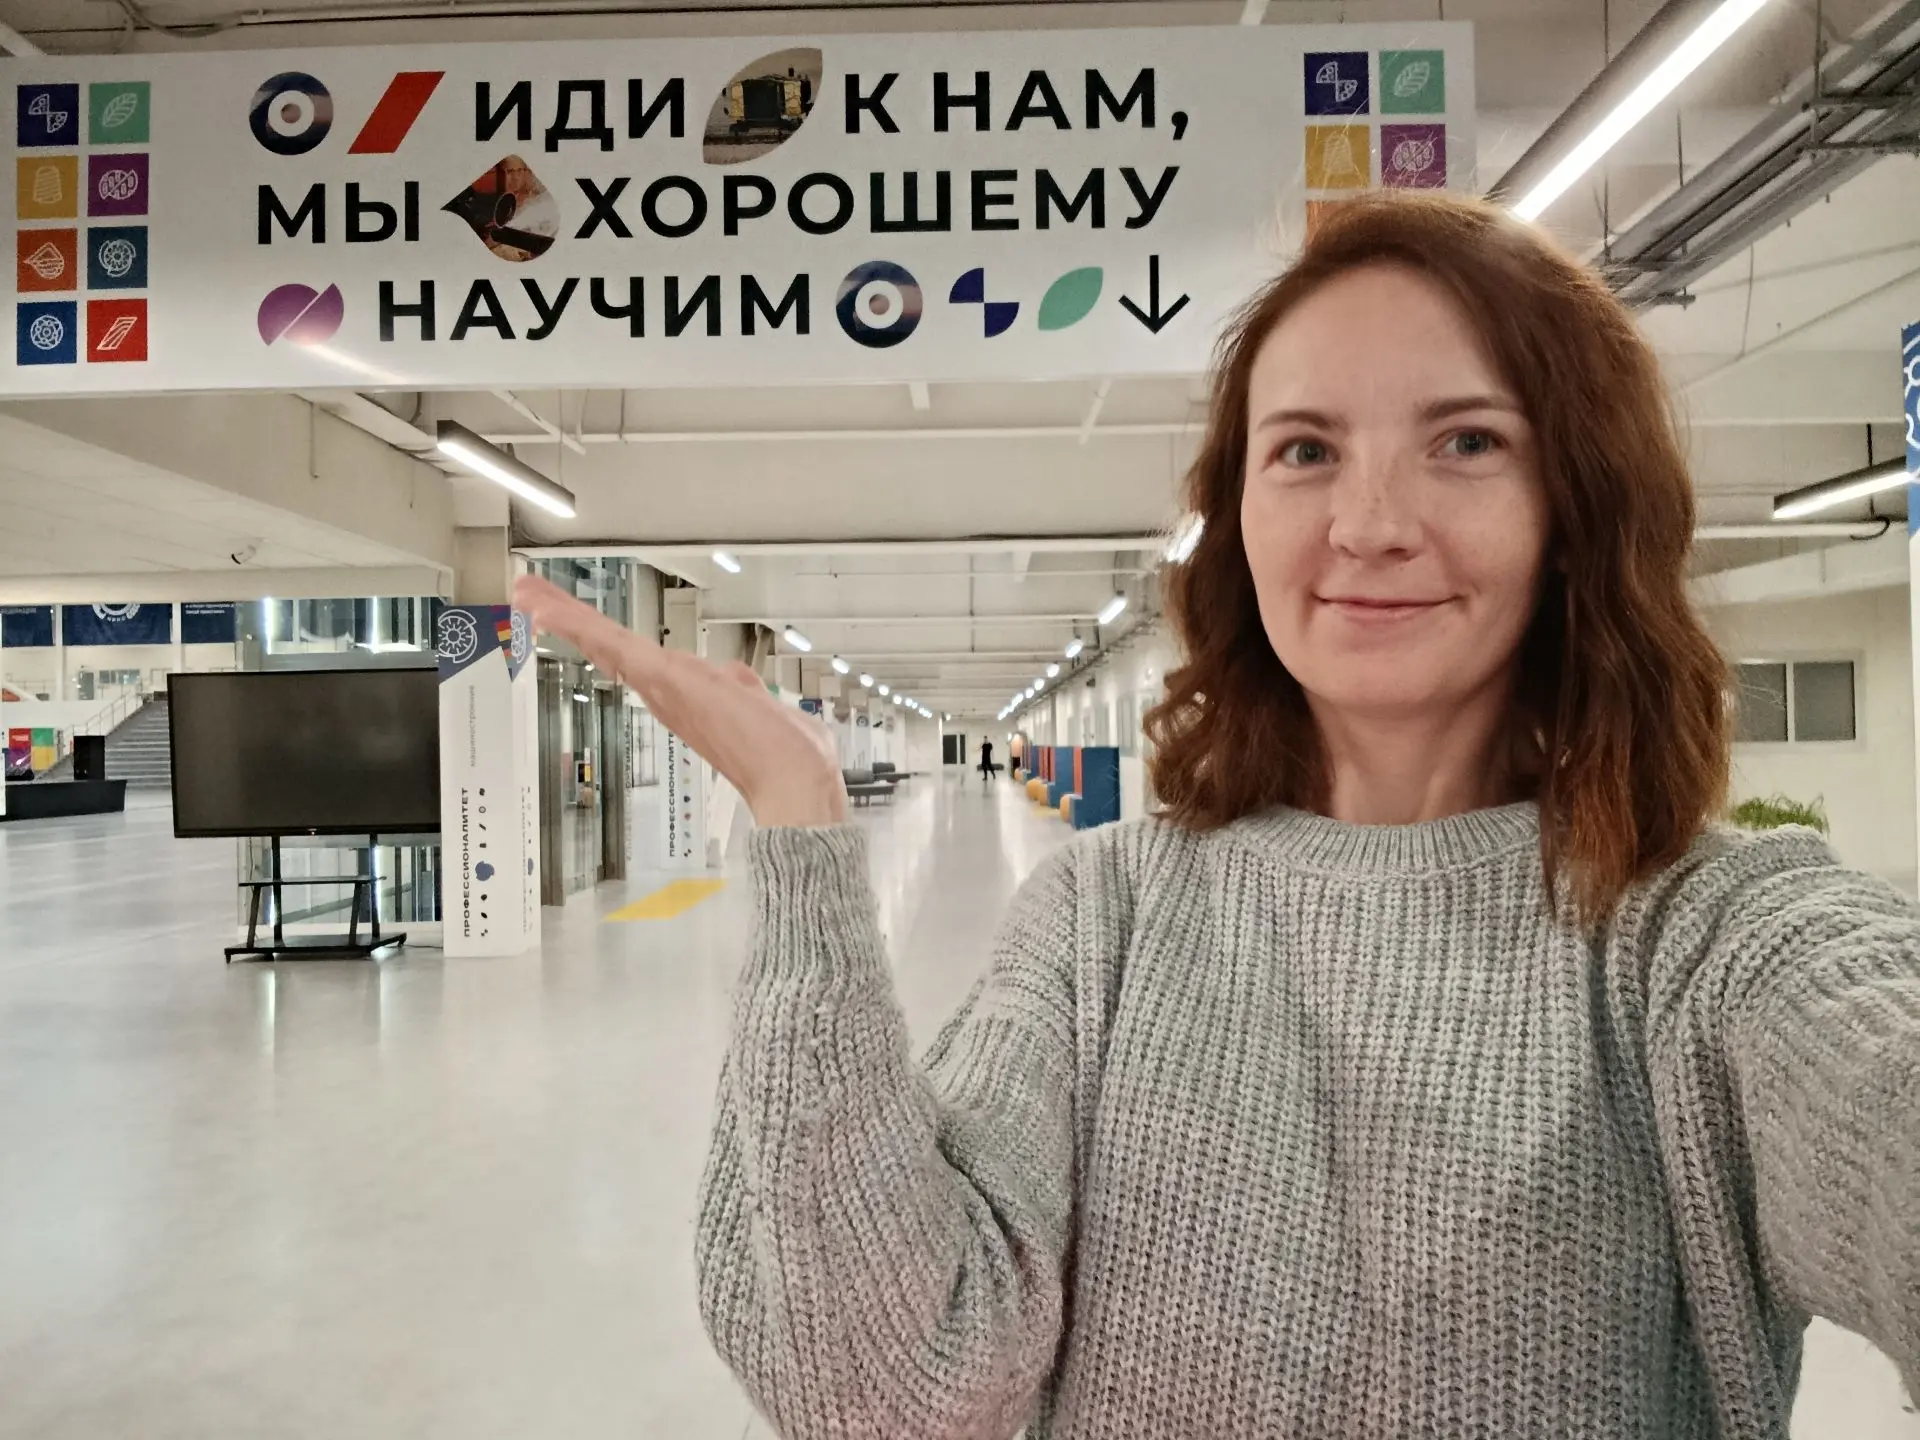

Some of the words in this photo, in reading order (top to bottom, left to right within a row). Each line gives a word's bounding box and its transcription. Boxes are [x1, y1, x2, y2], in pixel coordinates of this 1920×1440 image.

[476, 78, 684, 152] ИДИ
[846, 72, 899, 133] К
[934, 68, 1189, 141] НАМ,
[258, 182, 419, 245] МЫ
[575, 167, 1180, 238] ХОРОШЕМУ
[379, 274, 809, 341] НАУЧИМ
[668, 731, 676, 858] ПРОФЕССИОНАЛИТЕ
[461, 787, 471, 938] ПРОФЕССИОНАЛИТЕТ
